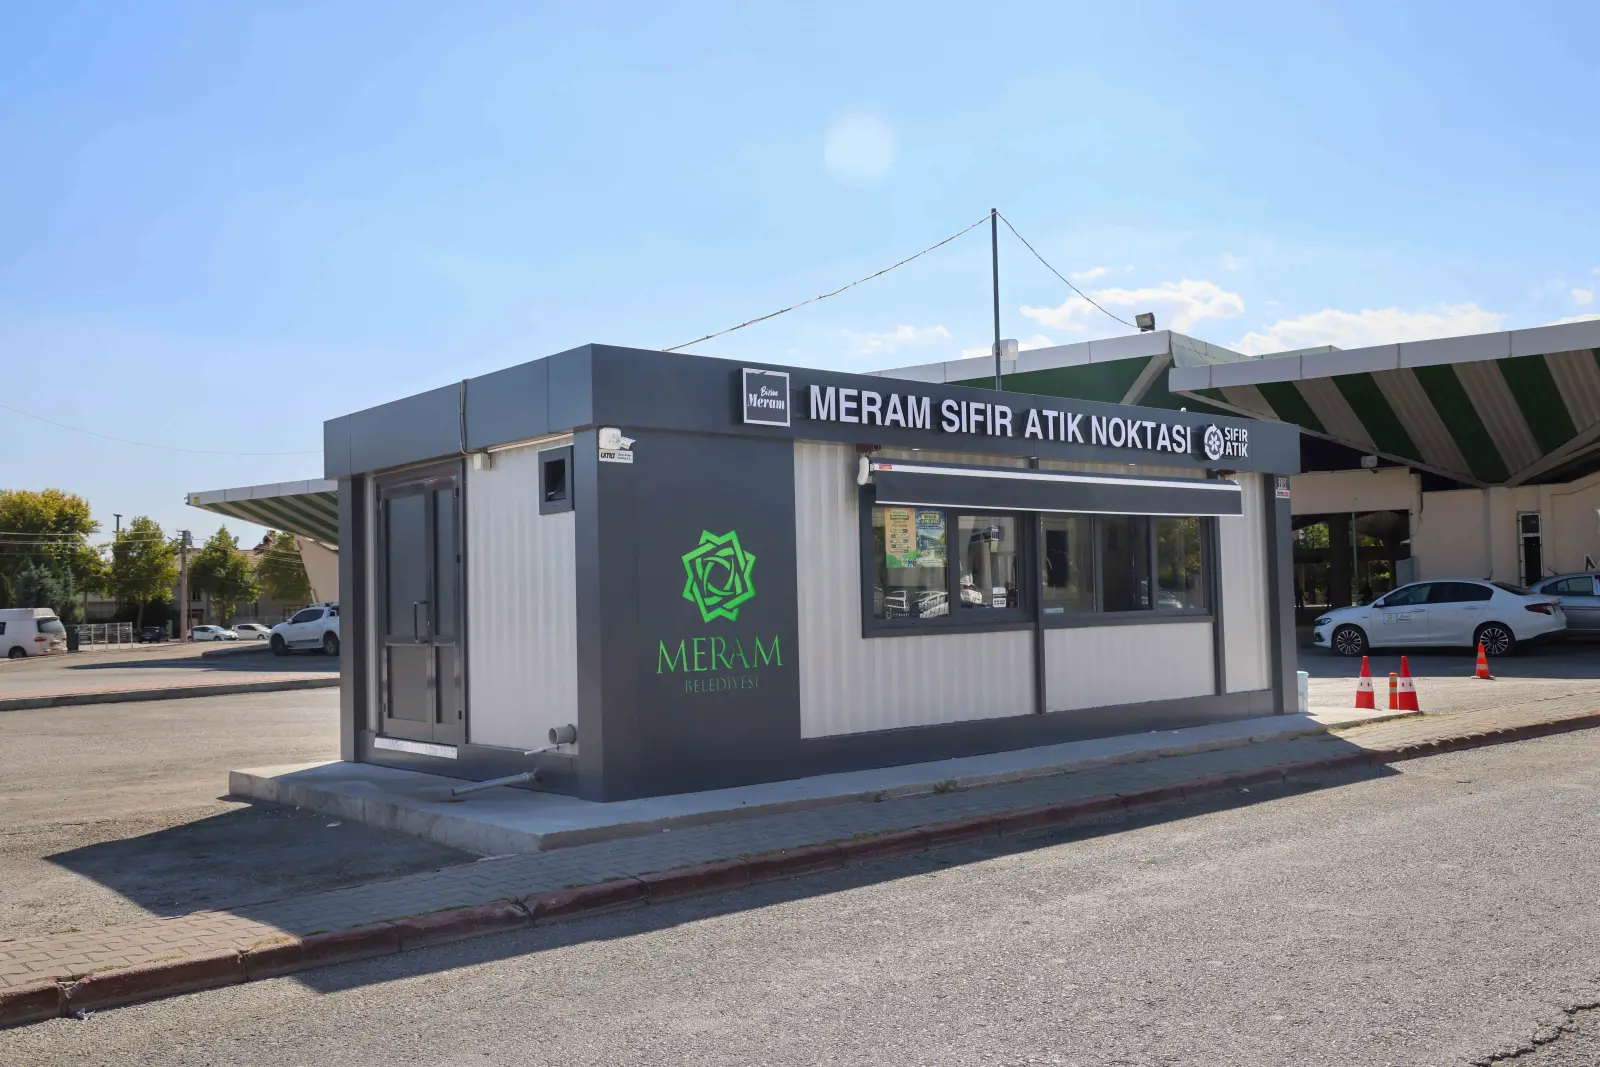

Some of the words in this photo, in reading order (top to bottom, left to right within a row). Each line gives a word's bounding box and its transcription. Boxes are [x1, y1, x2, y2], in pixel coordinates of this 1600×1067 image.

[747, 393, 786, 410] Meram
[810, 384, 932, 430] MERAM
[941, 398, 1013, 437] SIFIR
[1024, 408, 1085, 444] ATIK
[1091, 415, 1192, 454] NOKTASI
[1224, 426, 1249, 443] SIFIR
[1225, 441, 1249, 458] ATIK
[656, 634, 785, 674] MERAM
